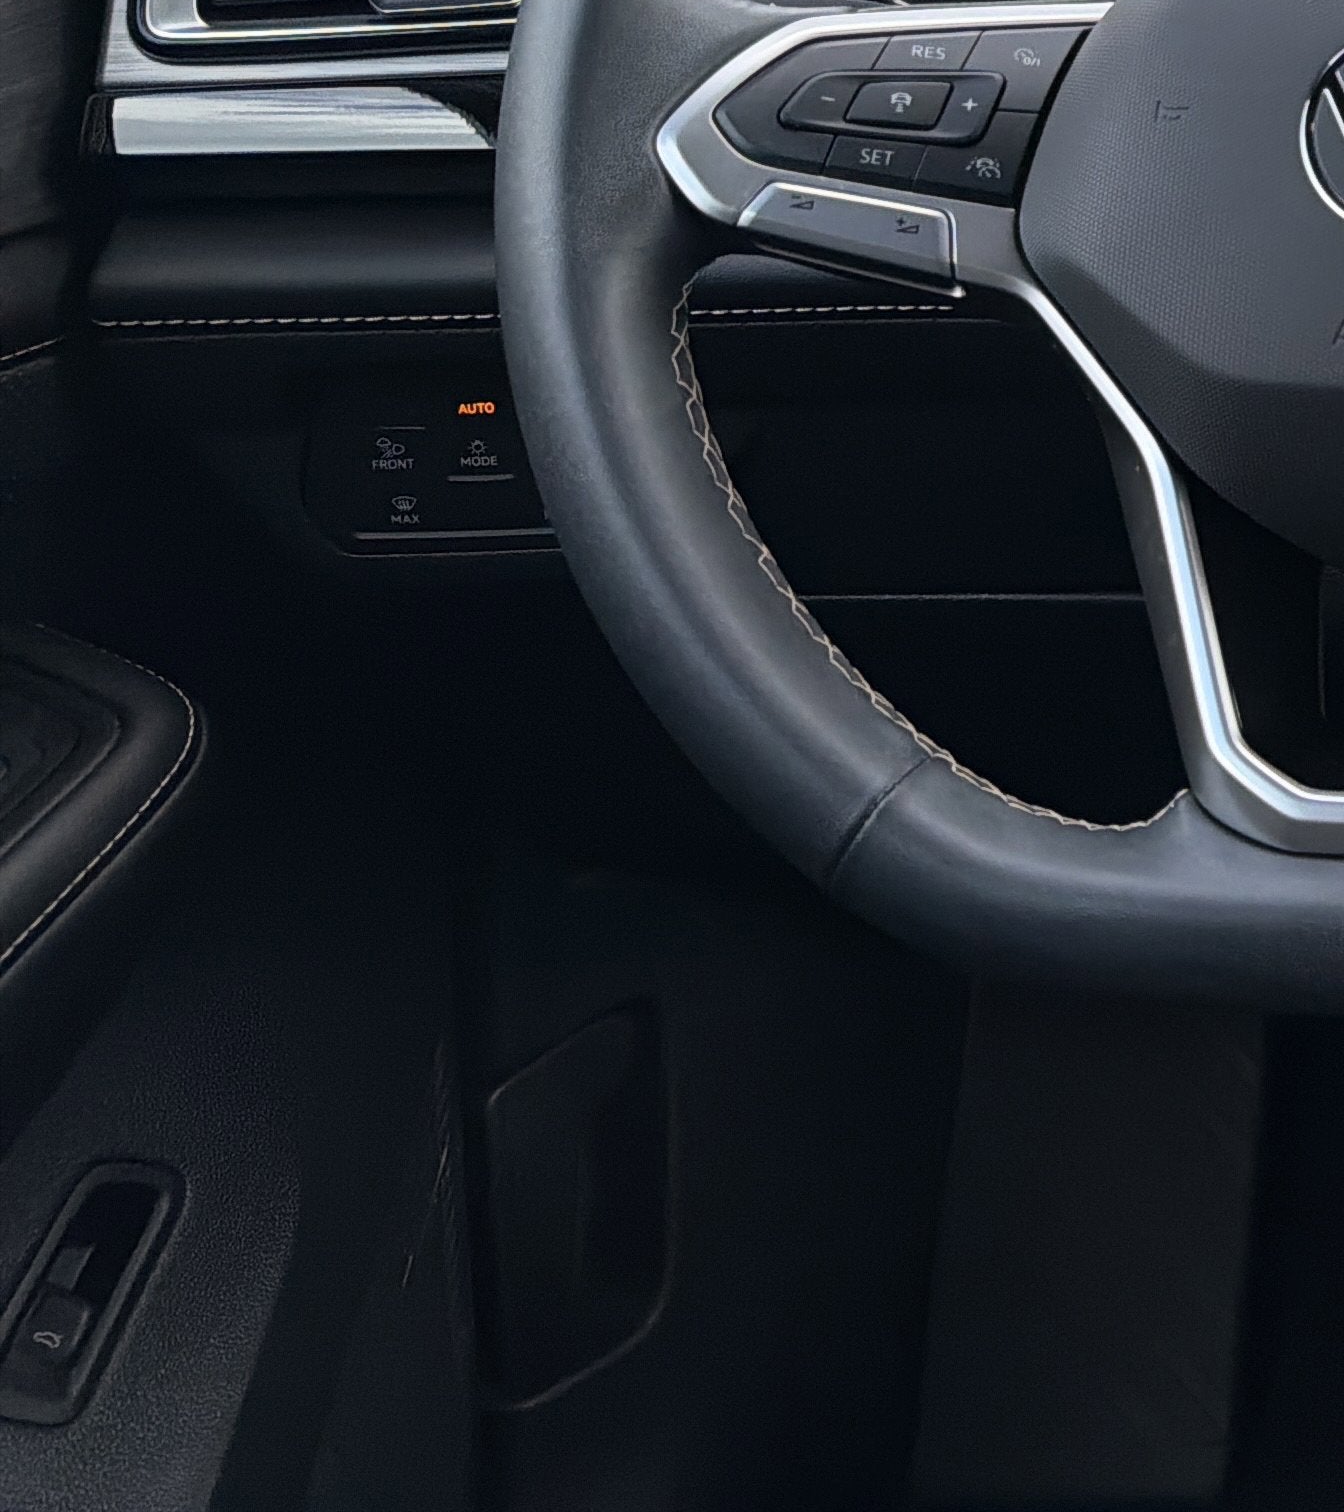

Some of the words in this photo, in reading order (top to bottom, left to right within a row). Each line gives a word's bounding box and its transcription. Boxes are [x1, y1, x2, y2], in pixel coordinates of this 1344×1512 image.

[912, 45, 945, 59] RES
[860, 148, 894, 165] SET
[459, 402, 494, 414] AUTO
[372, 458, 415, 470] FRONT
[460, 456, 498, 467] MODE
[391, 514, 419, 523] MAX
